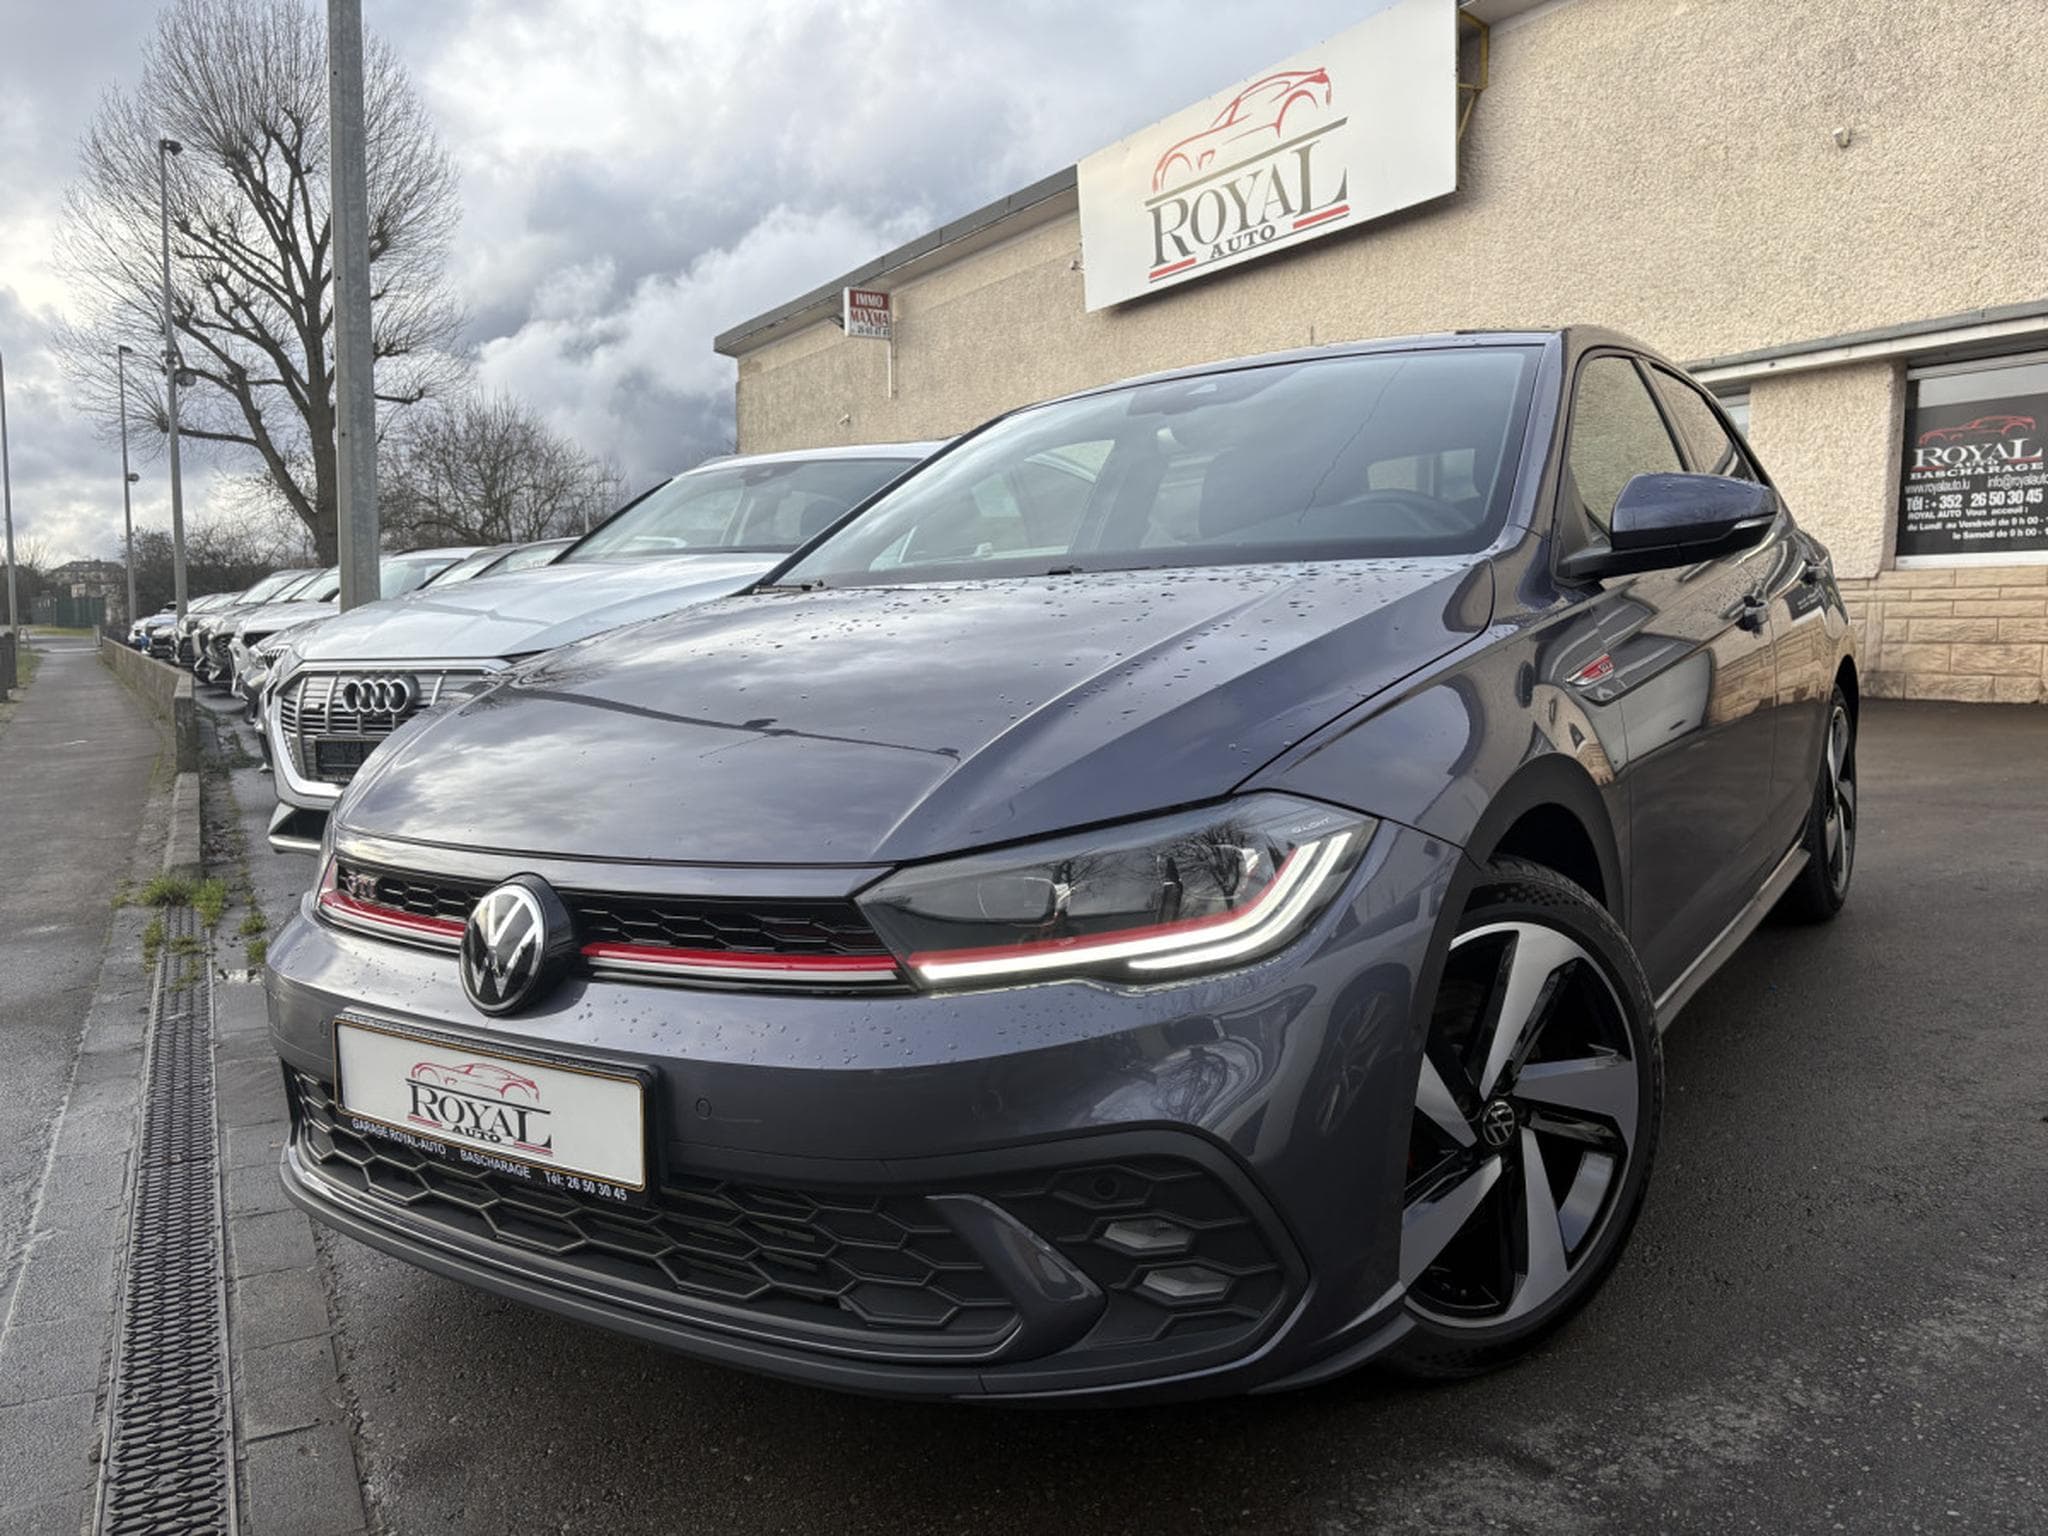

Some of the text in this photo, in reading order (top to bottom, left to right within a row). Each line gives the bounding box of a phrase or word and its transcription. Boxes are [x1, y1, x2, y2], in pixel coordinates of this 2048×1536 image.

[1147, 140, 1349, 268] ROYAL
[1209, 223, 1277, 259] AUTO
[855, 292, 884, 307] IMMO
[1913, 438, 2043, 467] ROYAL
[1910, 461, 2044, 480] BASCHARAGE
[1953, 458, 2000, 469] AUTO
[1904, 478, 1970, 496] www.royalauto.lu
[1970, 492, 1987, 507] 26
[1988, 491, 2006, 506] 50
[2006, 490, 2024, 505] 30
[2025, 487, 2043, 504] 45
[1907, 510, 1936, 520] ROYAL
[1937, 509, 1962, 518] AUTO
[1965, 507, 1988, 517] Vous
[1919, 521, 1943, 530] Lundi
[1958, 517, 1997, 529] Vendredi
[2026, 515, 2039, 525] 00
[1962, 529, 1996, 540] Samedi
[1996, 528, 2009, 538] de
[2024, 527, 2037, 537] 00
[406, 1083, 553, 1150] ROYAL
[451, 1125, 501, 1144] AUTO
[351, 1117, 389, 1139] GARAGE
[460, 1148, 532, 1180] BASCHARAGE
[544, 1170, 564, 1185] Tél:
[567, 1175, 581, 1191] 26
[583, 1179, 596, 1195] 50
[598, 1182, 612, 1198] 30
[613, 1187, 628, 1202] 45
